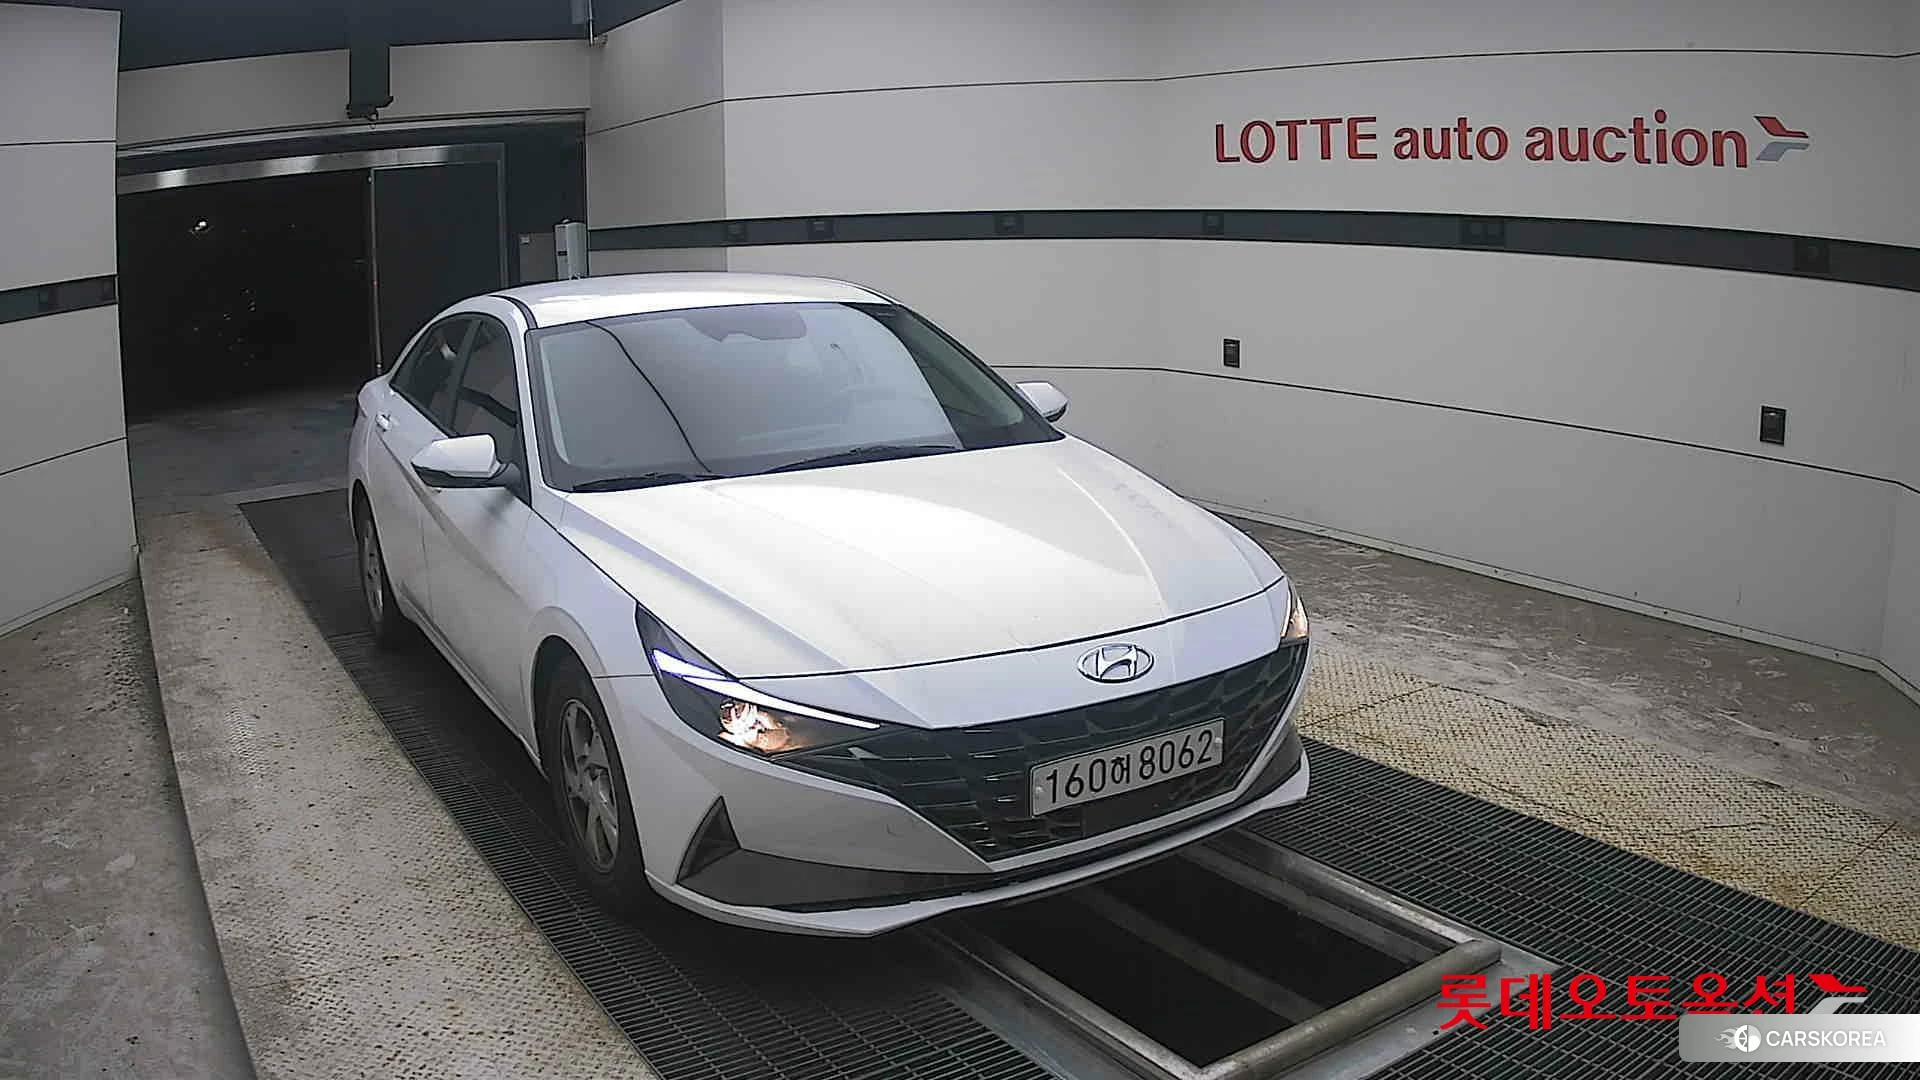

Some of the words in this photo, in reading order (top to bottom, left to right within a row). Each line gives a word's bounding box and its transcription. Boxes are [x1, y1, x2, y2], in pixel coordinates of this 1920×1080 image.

[1215, 116, 1377, 163] LOTTE
[1394, 117, 1508, 161] auto
[1525, 109, 1748, 169] auction
